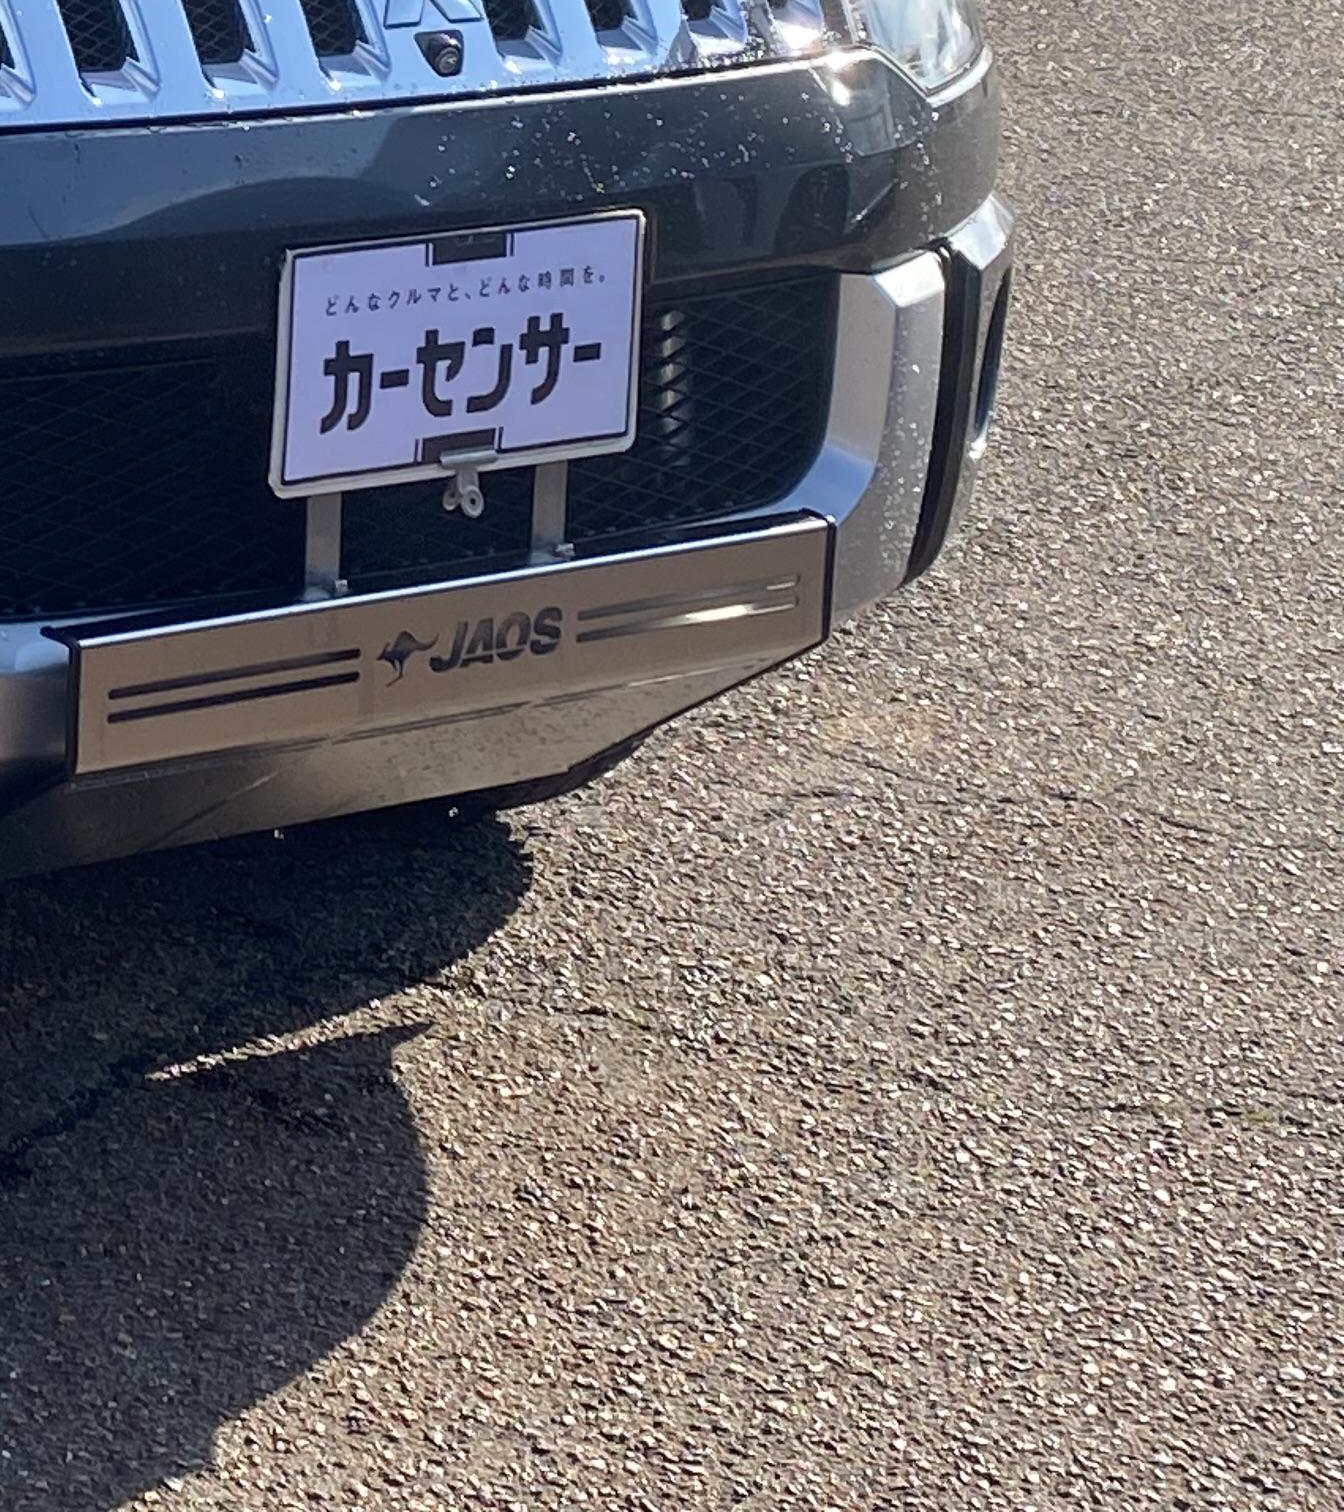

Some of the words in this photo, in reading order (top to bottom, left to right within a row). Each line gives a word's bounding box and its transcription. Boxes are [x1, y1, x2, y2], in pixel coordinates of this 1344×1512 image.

[324, 264, 607, 317] どんなクルマと、どんな時間を。
[319, 311, 602, 435] カーセンサー
[429, 607, 564, 674] JAOS
